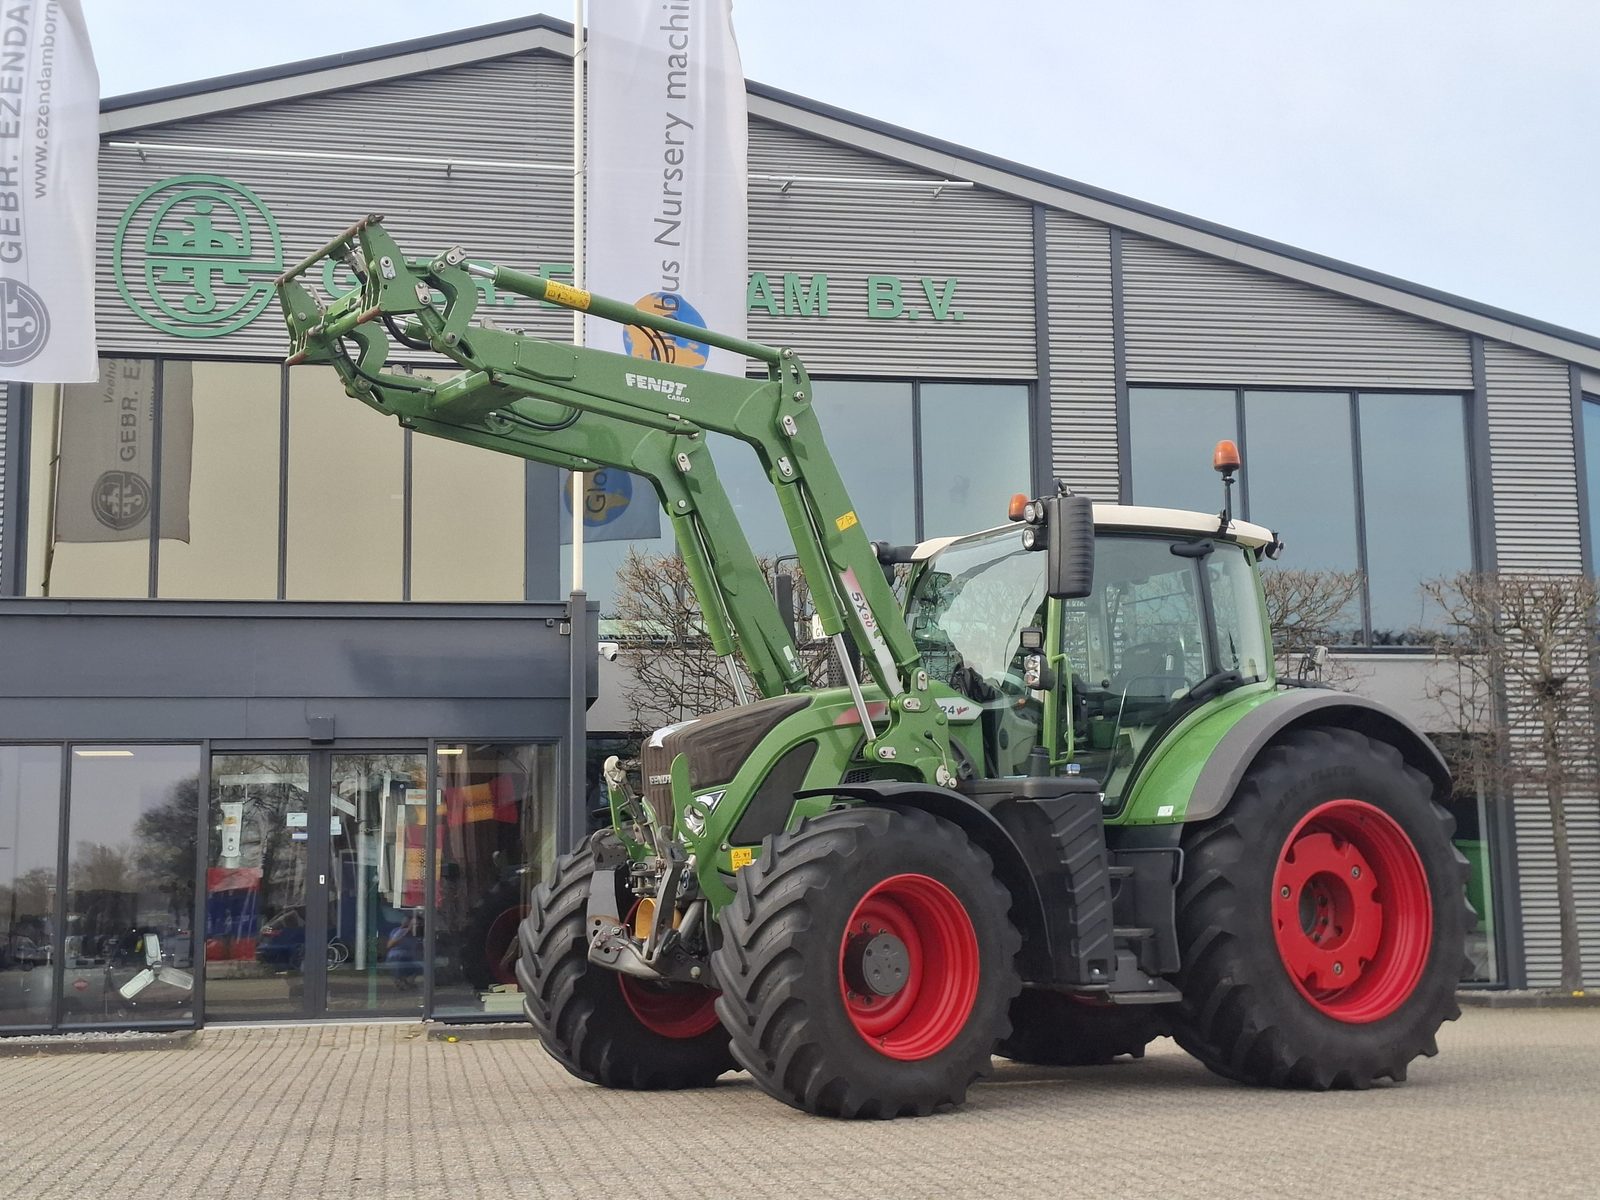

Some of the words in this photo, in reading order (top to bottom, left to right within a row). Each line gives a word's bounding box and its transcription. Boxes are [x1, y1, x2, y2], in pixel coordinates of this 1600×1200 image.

[0, 0, 30, 139] EZENDA
[659, 0, 690, 99] machi
[34, 0, 59, 200] www.ezendamborn
[653, 111, 694, 247] Nursery
[746, 271, 829, 317] AM
[867, 275, 965, 321] B.V.
[625, 372, 688, 396] FENDT
[666, 393, 691, 403] CARGO
[120, 391, 139, 463] GEBR.
[586, 470, 608, 514] Glo
[940, 705, 956, 715] 24
